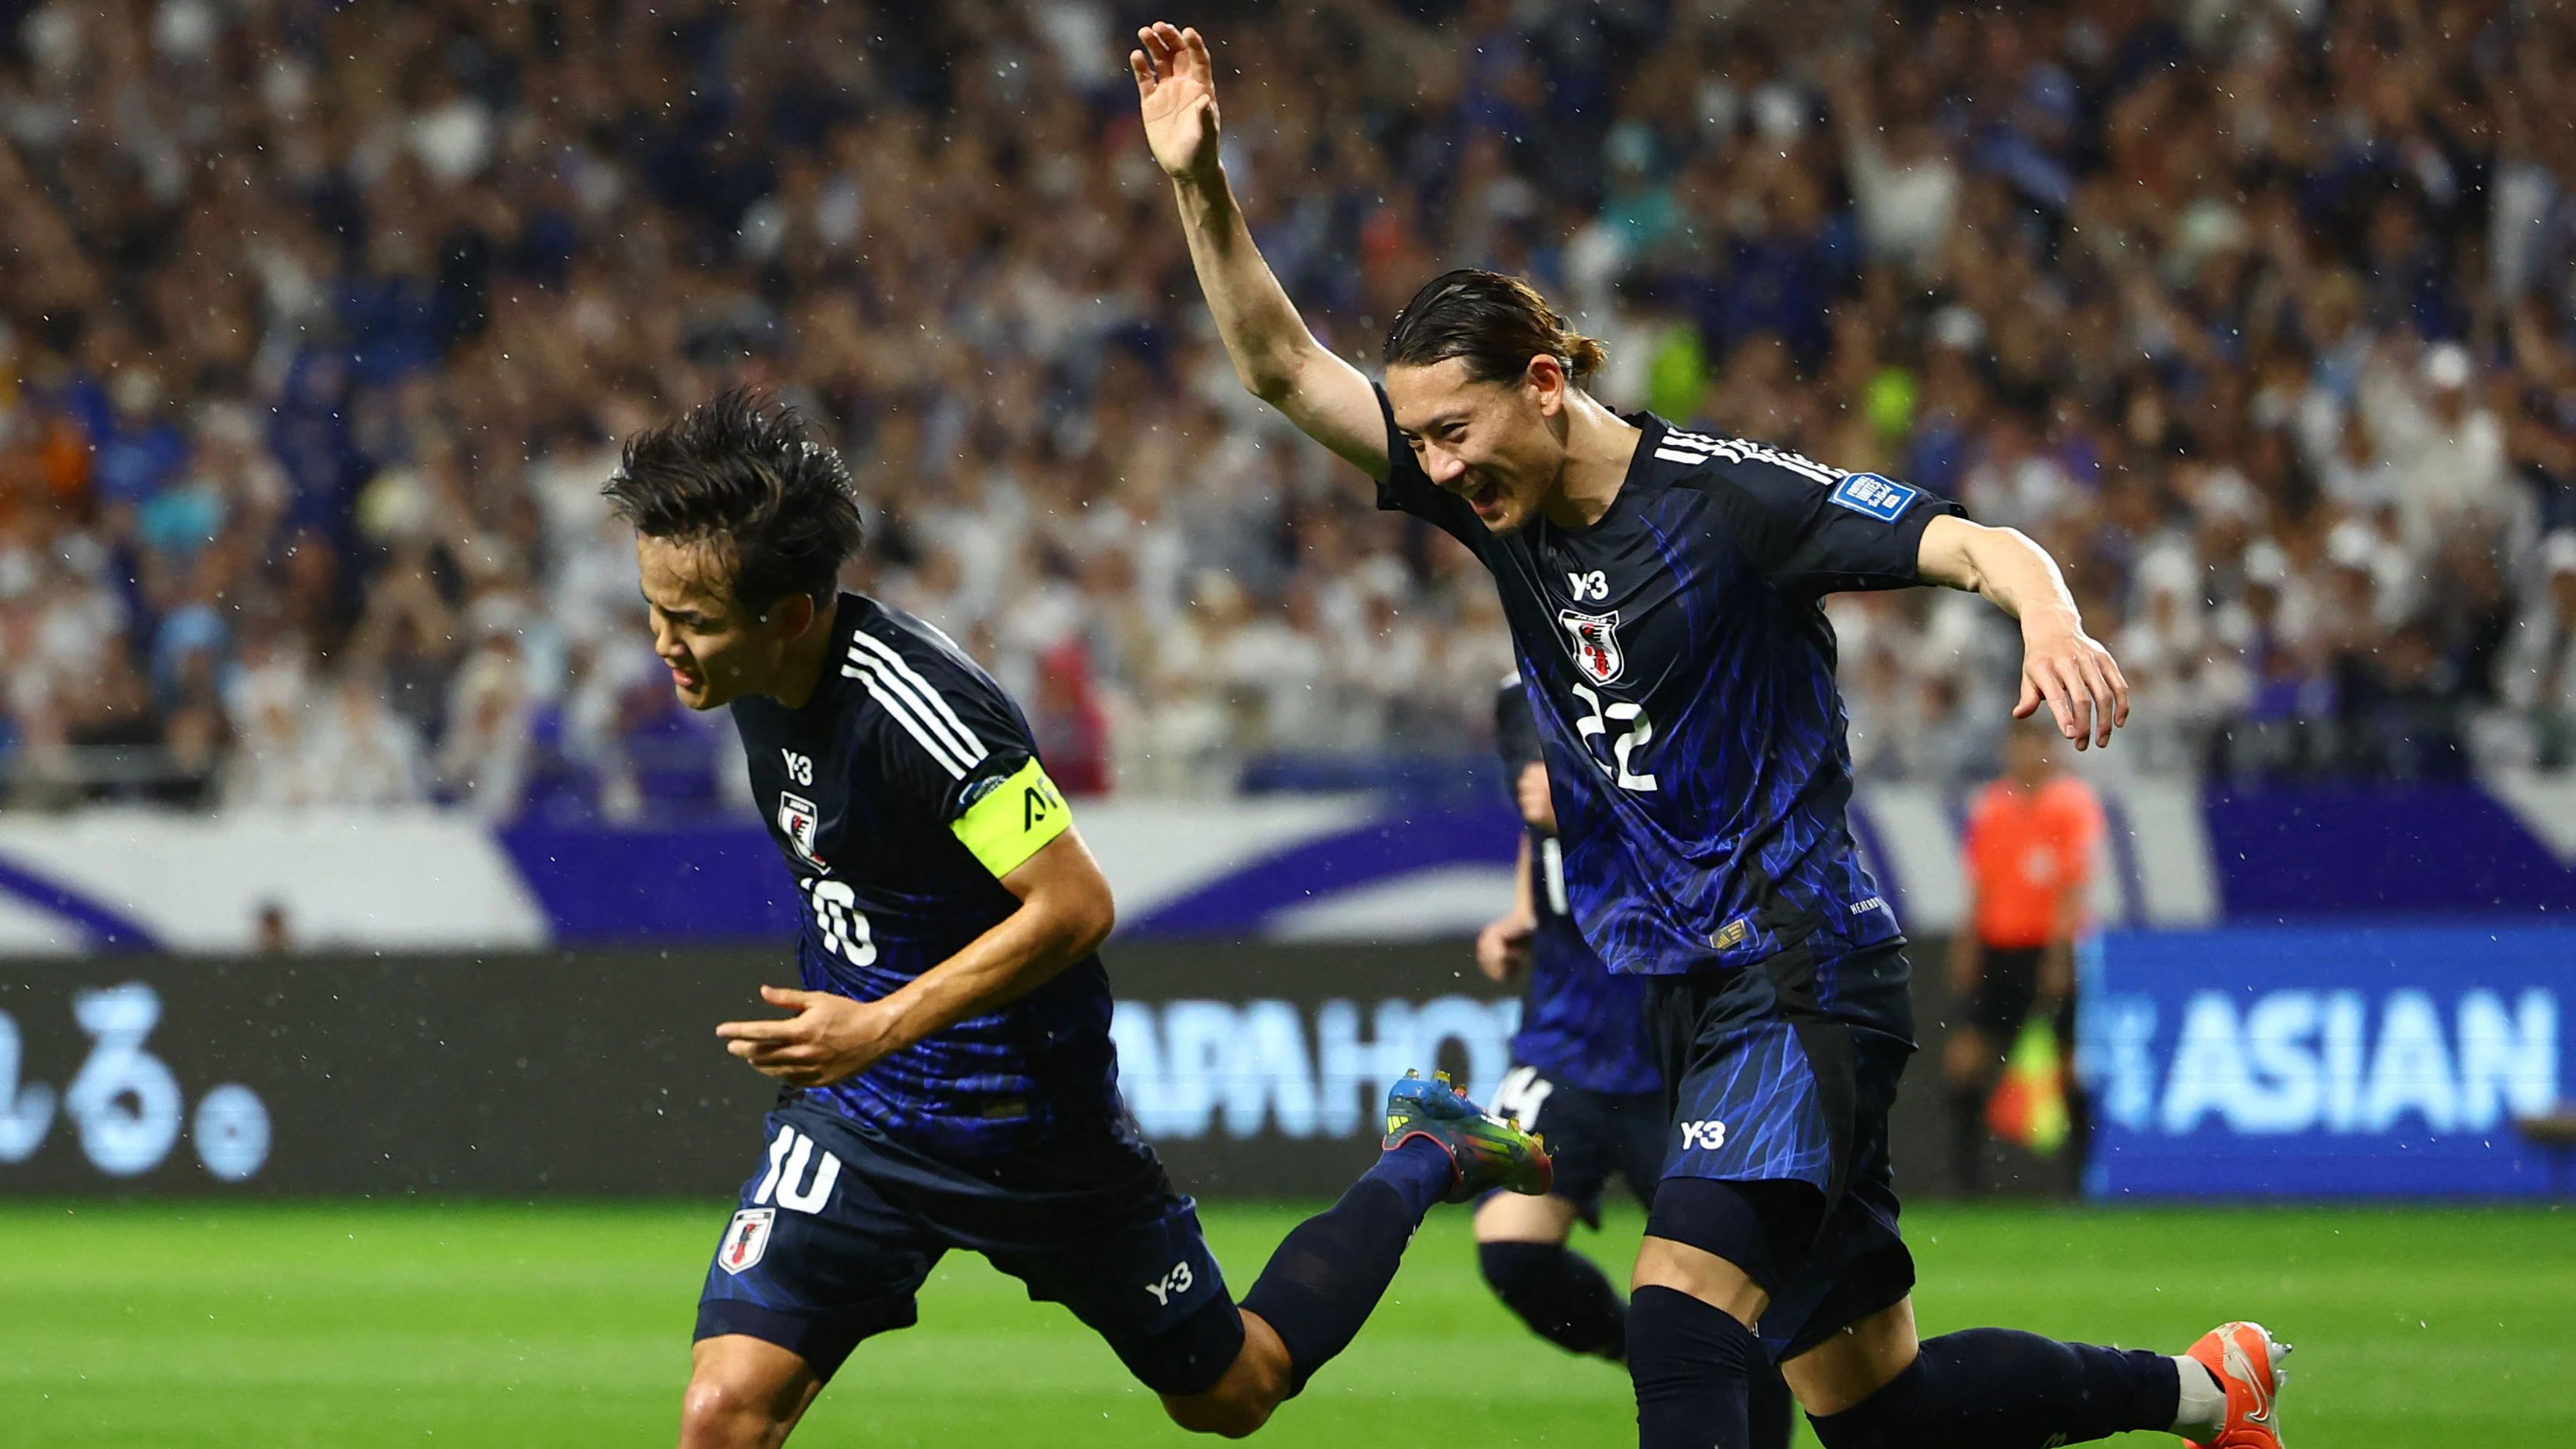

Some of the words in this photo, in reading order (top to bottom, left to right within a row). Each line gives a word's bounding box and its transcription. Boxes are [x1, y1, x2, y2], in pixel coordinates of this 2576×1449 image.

[1568, 570, 1609, 601] Y-3
[781, 747, 813, 787] Y-3
[1572, 682, 1658, 791] 22
[800, 876, 877, 967] 10
[2161, 988, 2559, 1134] ASIAN
[1681, 1120, 1726, 1150] Y-3
[753, 1125, 842, 1215] 10
[1145, 1260, 1193, 1306] Y-3
